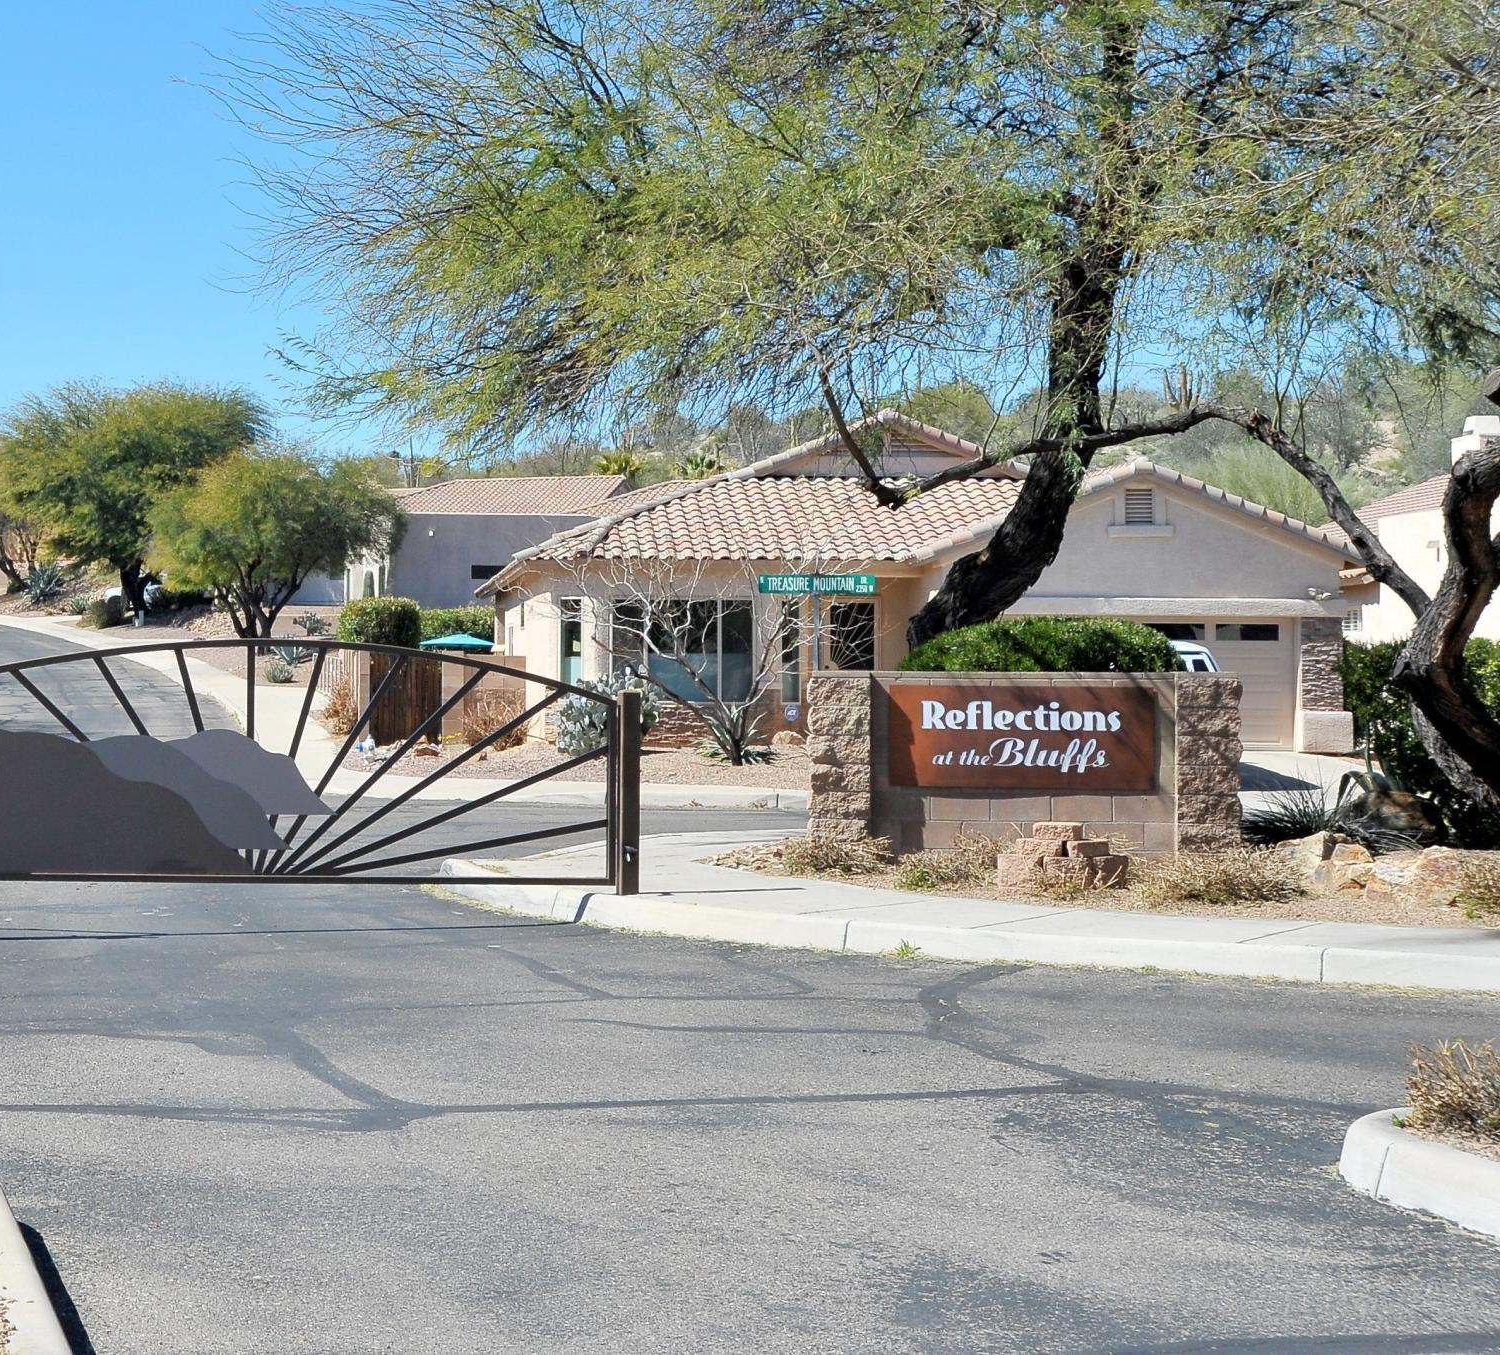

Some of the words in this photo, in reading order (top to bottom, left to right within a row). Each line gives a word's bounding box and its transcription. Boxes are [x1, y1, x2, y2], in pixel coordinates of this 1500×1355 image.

[767, 577, 810, 591] TREASURE
[813, 577, 855, 592] MOUNTAIN
[921, 700, 1121, 732] Reflections
[932, 751, 952, 766] at
[959, 748, 990, 767] the
[989, 737, 1110, 774] Bluffs
